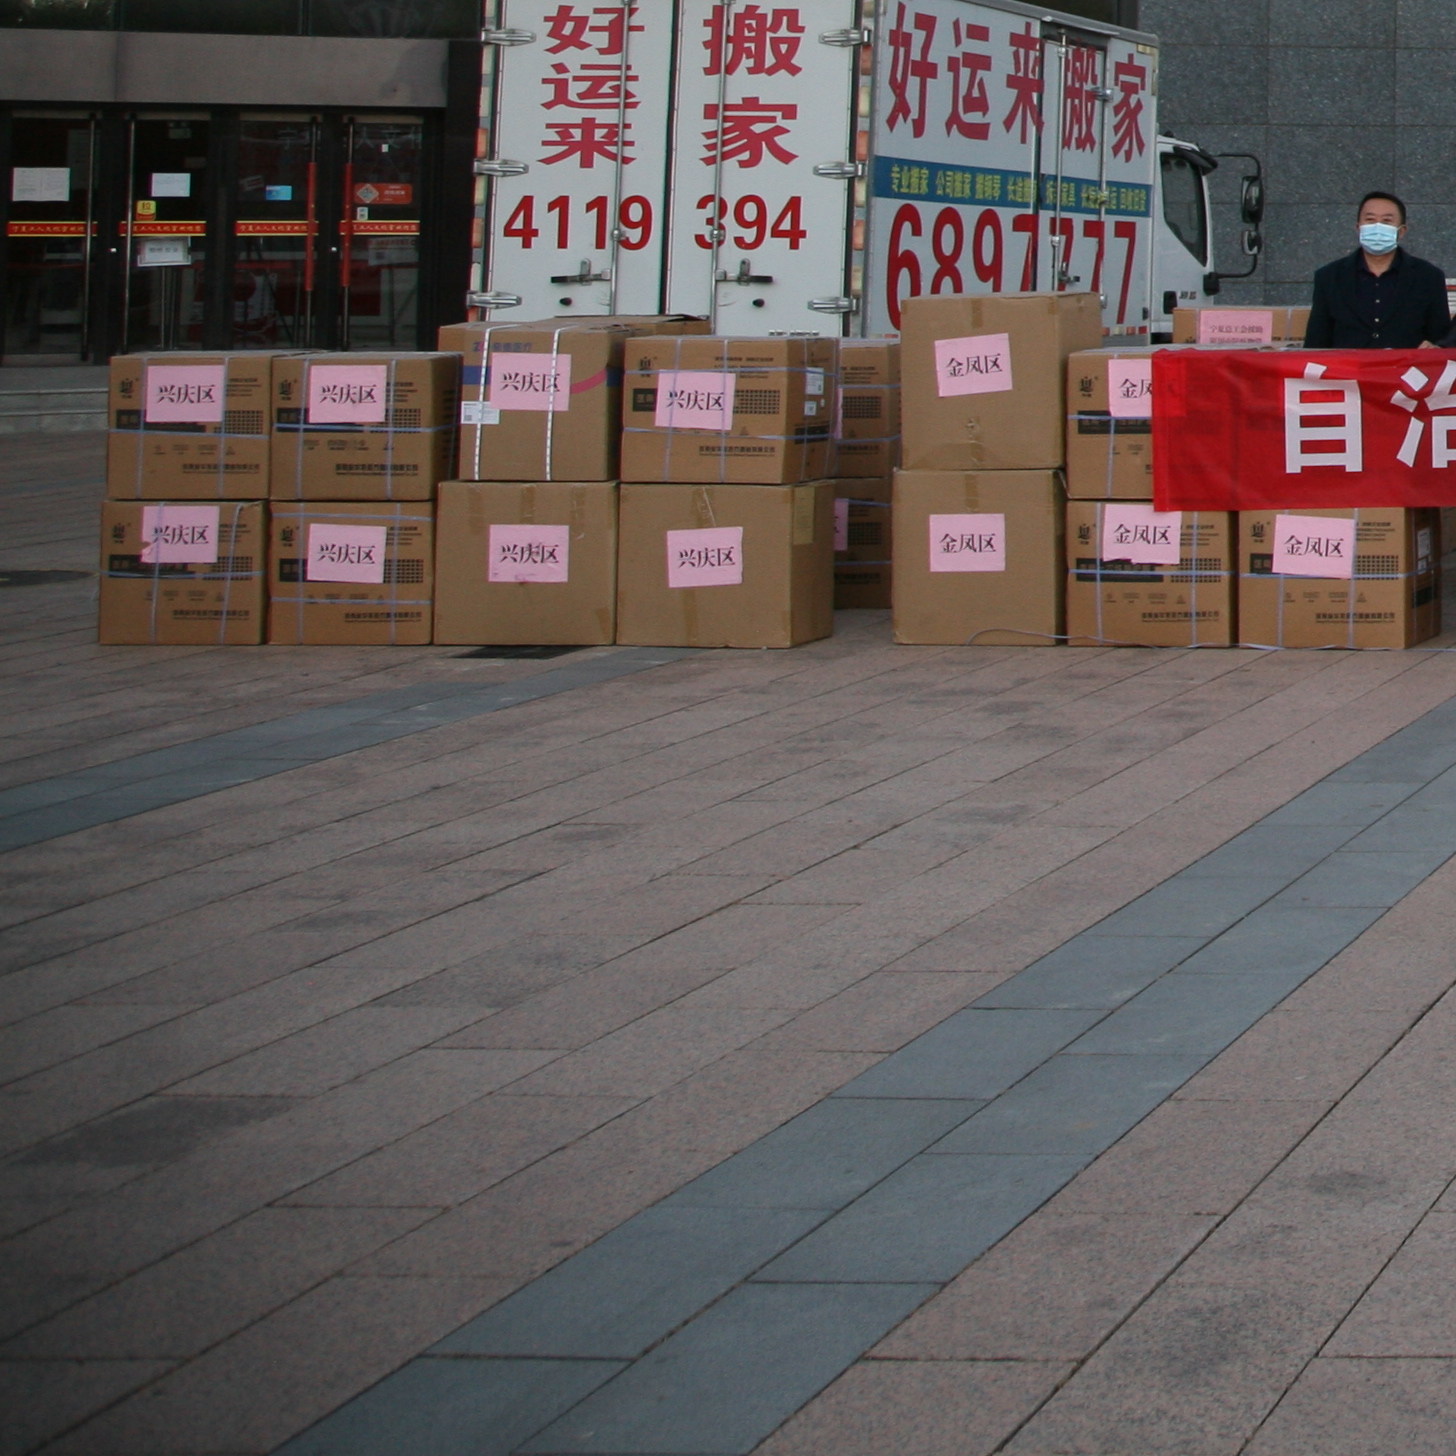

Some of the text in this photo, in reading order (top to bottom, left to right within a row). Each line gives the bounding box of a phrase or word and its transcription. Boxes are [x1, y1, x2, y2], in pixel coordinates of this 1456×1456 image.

[537, 5, 645, 169] 好运来
[699, 4, 806, 169] 搬家
[886, 0, 1146, 163] 好运来搬家
[503, 193, 807, 251] 4119 394
[945, 353, 1003, 378] 金凤区
[157, 384, 215, 404] 兴庆区
[500, 372, 560, 393] 兴庆区
[320, 384, 377, 405] 兴庆区
[666, 389, 725, 412] 兴庆区
[152, 525, 209, 545] 兴庆区
[939, 532, 997, 554] 金凤区
[1113, 523, 1171, 545] 金凤区
[317, 544, 376, 565] 兴庆区
[500, 542, 560, 565] 兴庆区
[678, 545, 736, 569] 兴庆区
[1284, 536, 1344, 559] 金凤区
